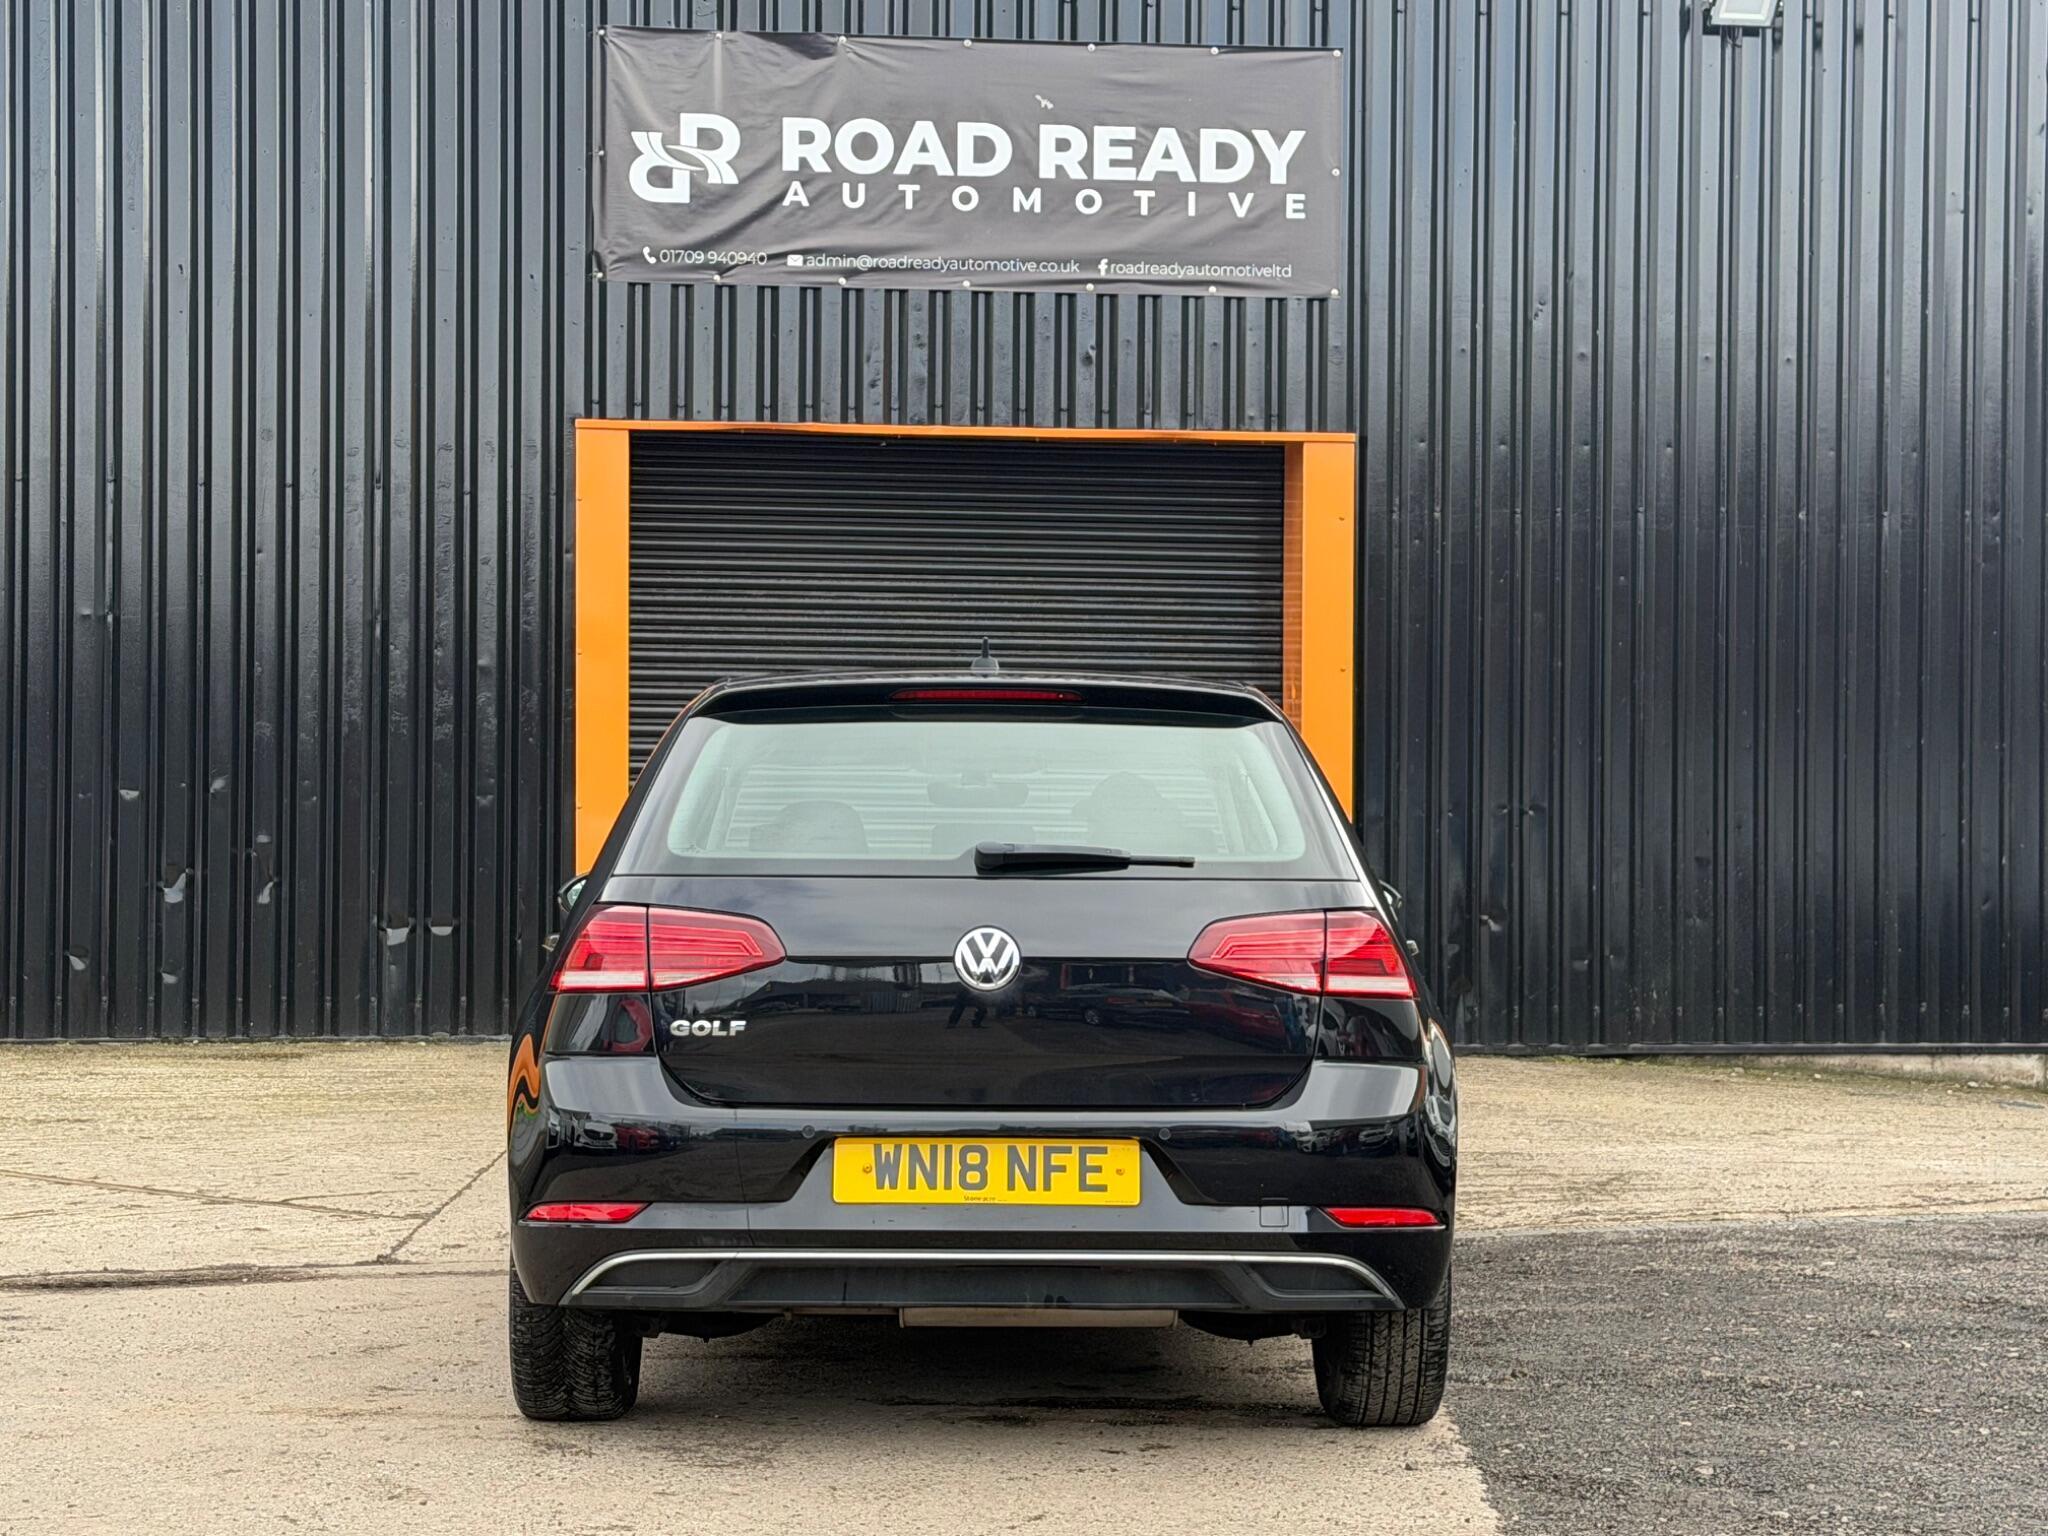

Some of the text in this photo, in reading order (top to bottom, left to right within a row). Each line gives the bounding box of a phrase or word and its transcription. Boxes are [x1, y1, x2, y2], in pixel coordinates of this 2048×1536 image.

[782, 117, 1306, 184] ROAD READY
[783, 181, 1306, 219] AUTOMOTIVE
[659, 249, 767, 265] 01709 940940
[806, 253, 1080, 273] admin@roadreadyautomotive.co.uk
[1110, 261, 1292, 278] roadreadyautomotiveltd
[669, 1019, 747, 1037] GOLF
[873, 1143, 1108, 1192] WN18 NFE
